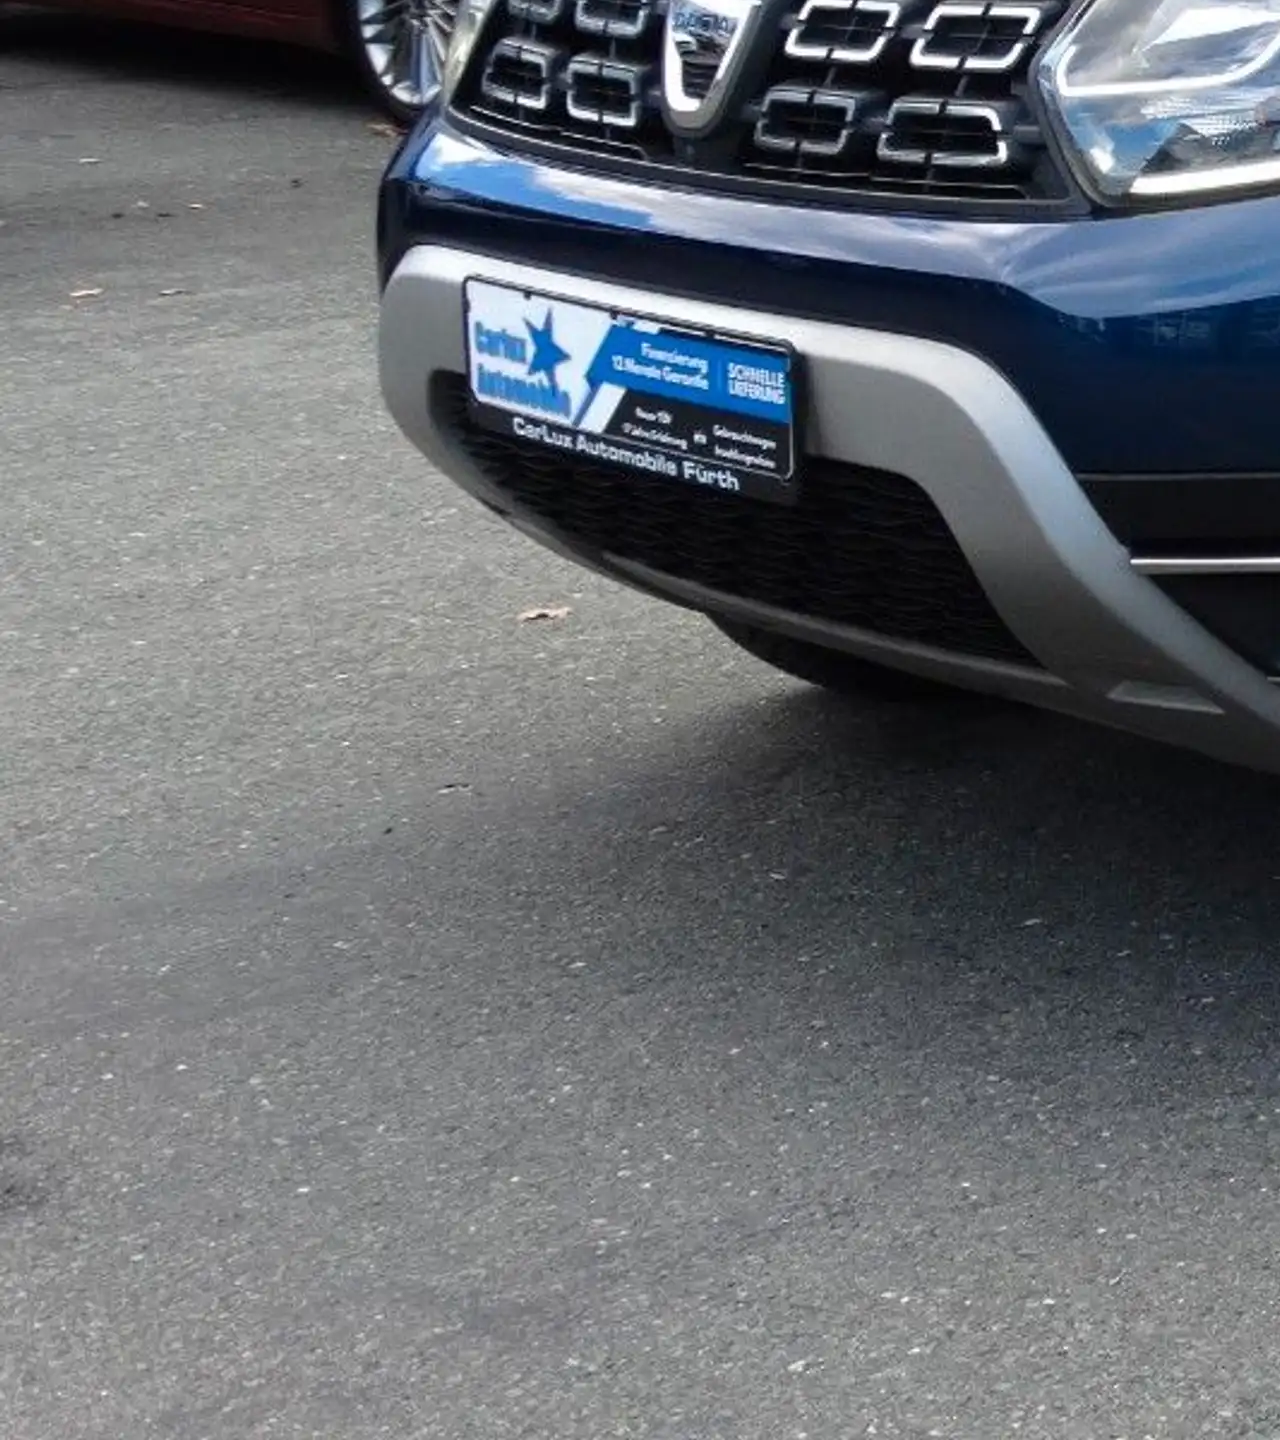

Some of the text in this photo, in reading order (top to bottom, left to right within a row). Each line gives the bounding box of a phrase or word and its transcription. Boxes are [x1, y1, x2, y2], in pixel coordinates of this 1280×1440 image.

[727, 362, 784, 387] SCHNELLE
[728, 378, 786, 405] LIEFERUNG
[575, 432, 677, 476] Automobile
[683, 461, 740, 491] Fürth
